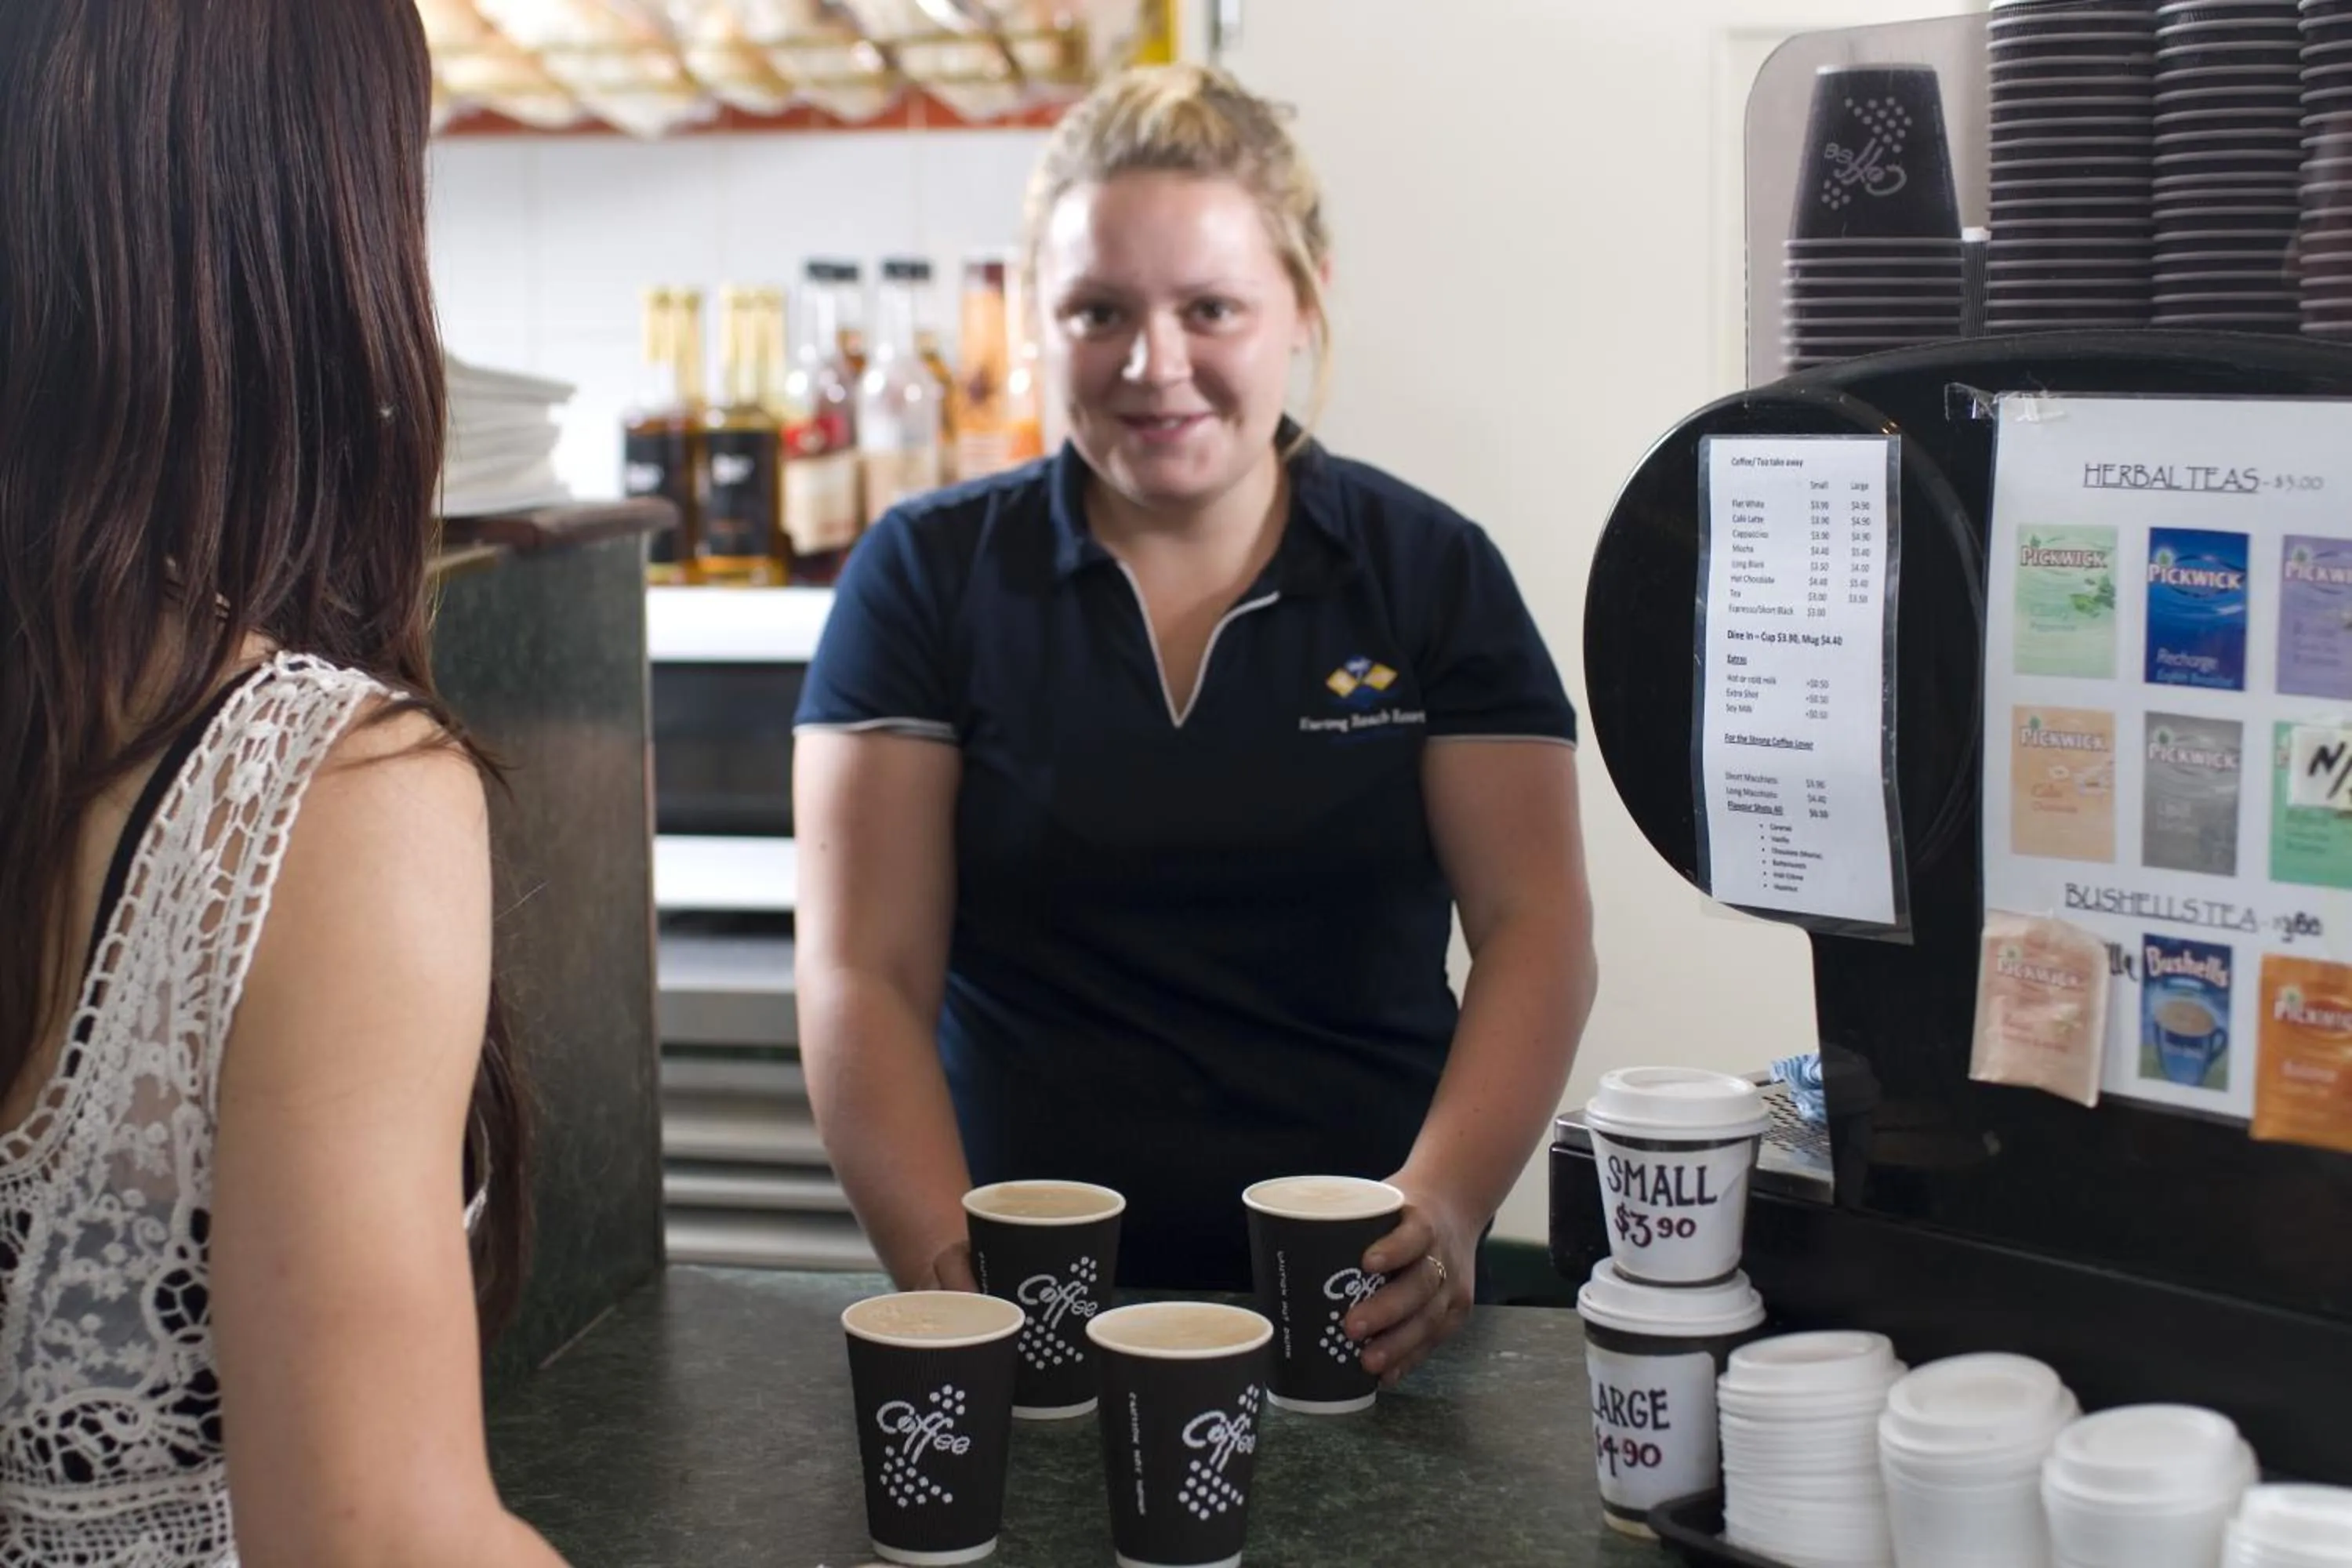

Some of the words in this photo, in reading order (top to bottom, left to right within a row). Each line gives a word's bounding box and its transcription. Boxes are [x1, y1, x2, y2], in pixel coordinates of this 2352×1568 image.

[2083, 463, 2183, 490] HERBAL
[2185, 466, 2261, 493] TEAS
[2020, 545, 2108, 568] PICKWICK
[2147, 563, 2244, 590] PICKWICK
[1730, 589, 1741, 597] Tea
[1727, 630, 1744, 640] Dine
[1760, 632, 1776, 643] Cup
[1802, 633, 1820, 646] Mug
[2157, 647, 2220, 674] Recharge
[1350, 709, 1390, 728] Beach
[1725, 733, 1736, 744] For
[1737, 735, 1748, 745] the
[2020, 726, 2108, 752] PICKWICK
[2147, 742, 2239, 770] PICKWICK
[2065, 883, 2200, 925] BUSHELLS
[2201, 900, 2259, 933] TEA
[2145, 944, 2229, 989] Bushells
[1607, 1154, 1718, 1208] SMALL
[1018, 1273, 1098, 1330] Coffee
[876, 1400, 971, 1465] Coffee
[1182, 1410, 1256, 1472] Coffee
